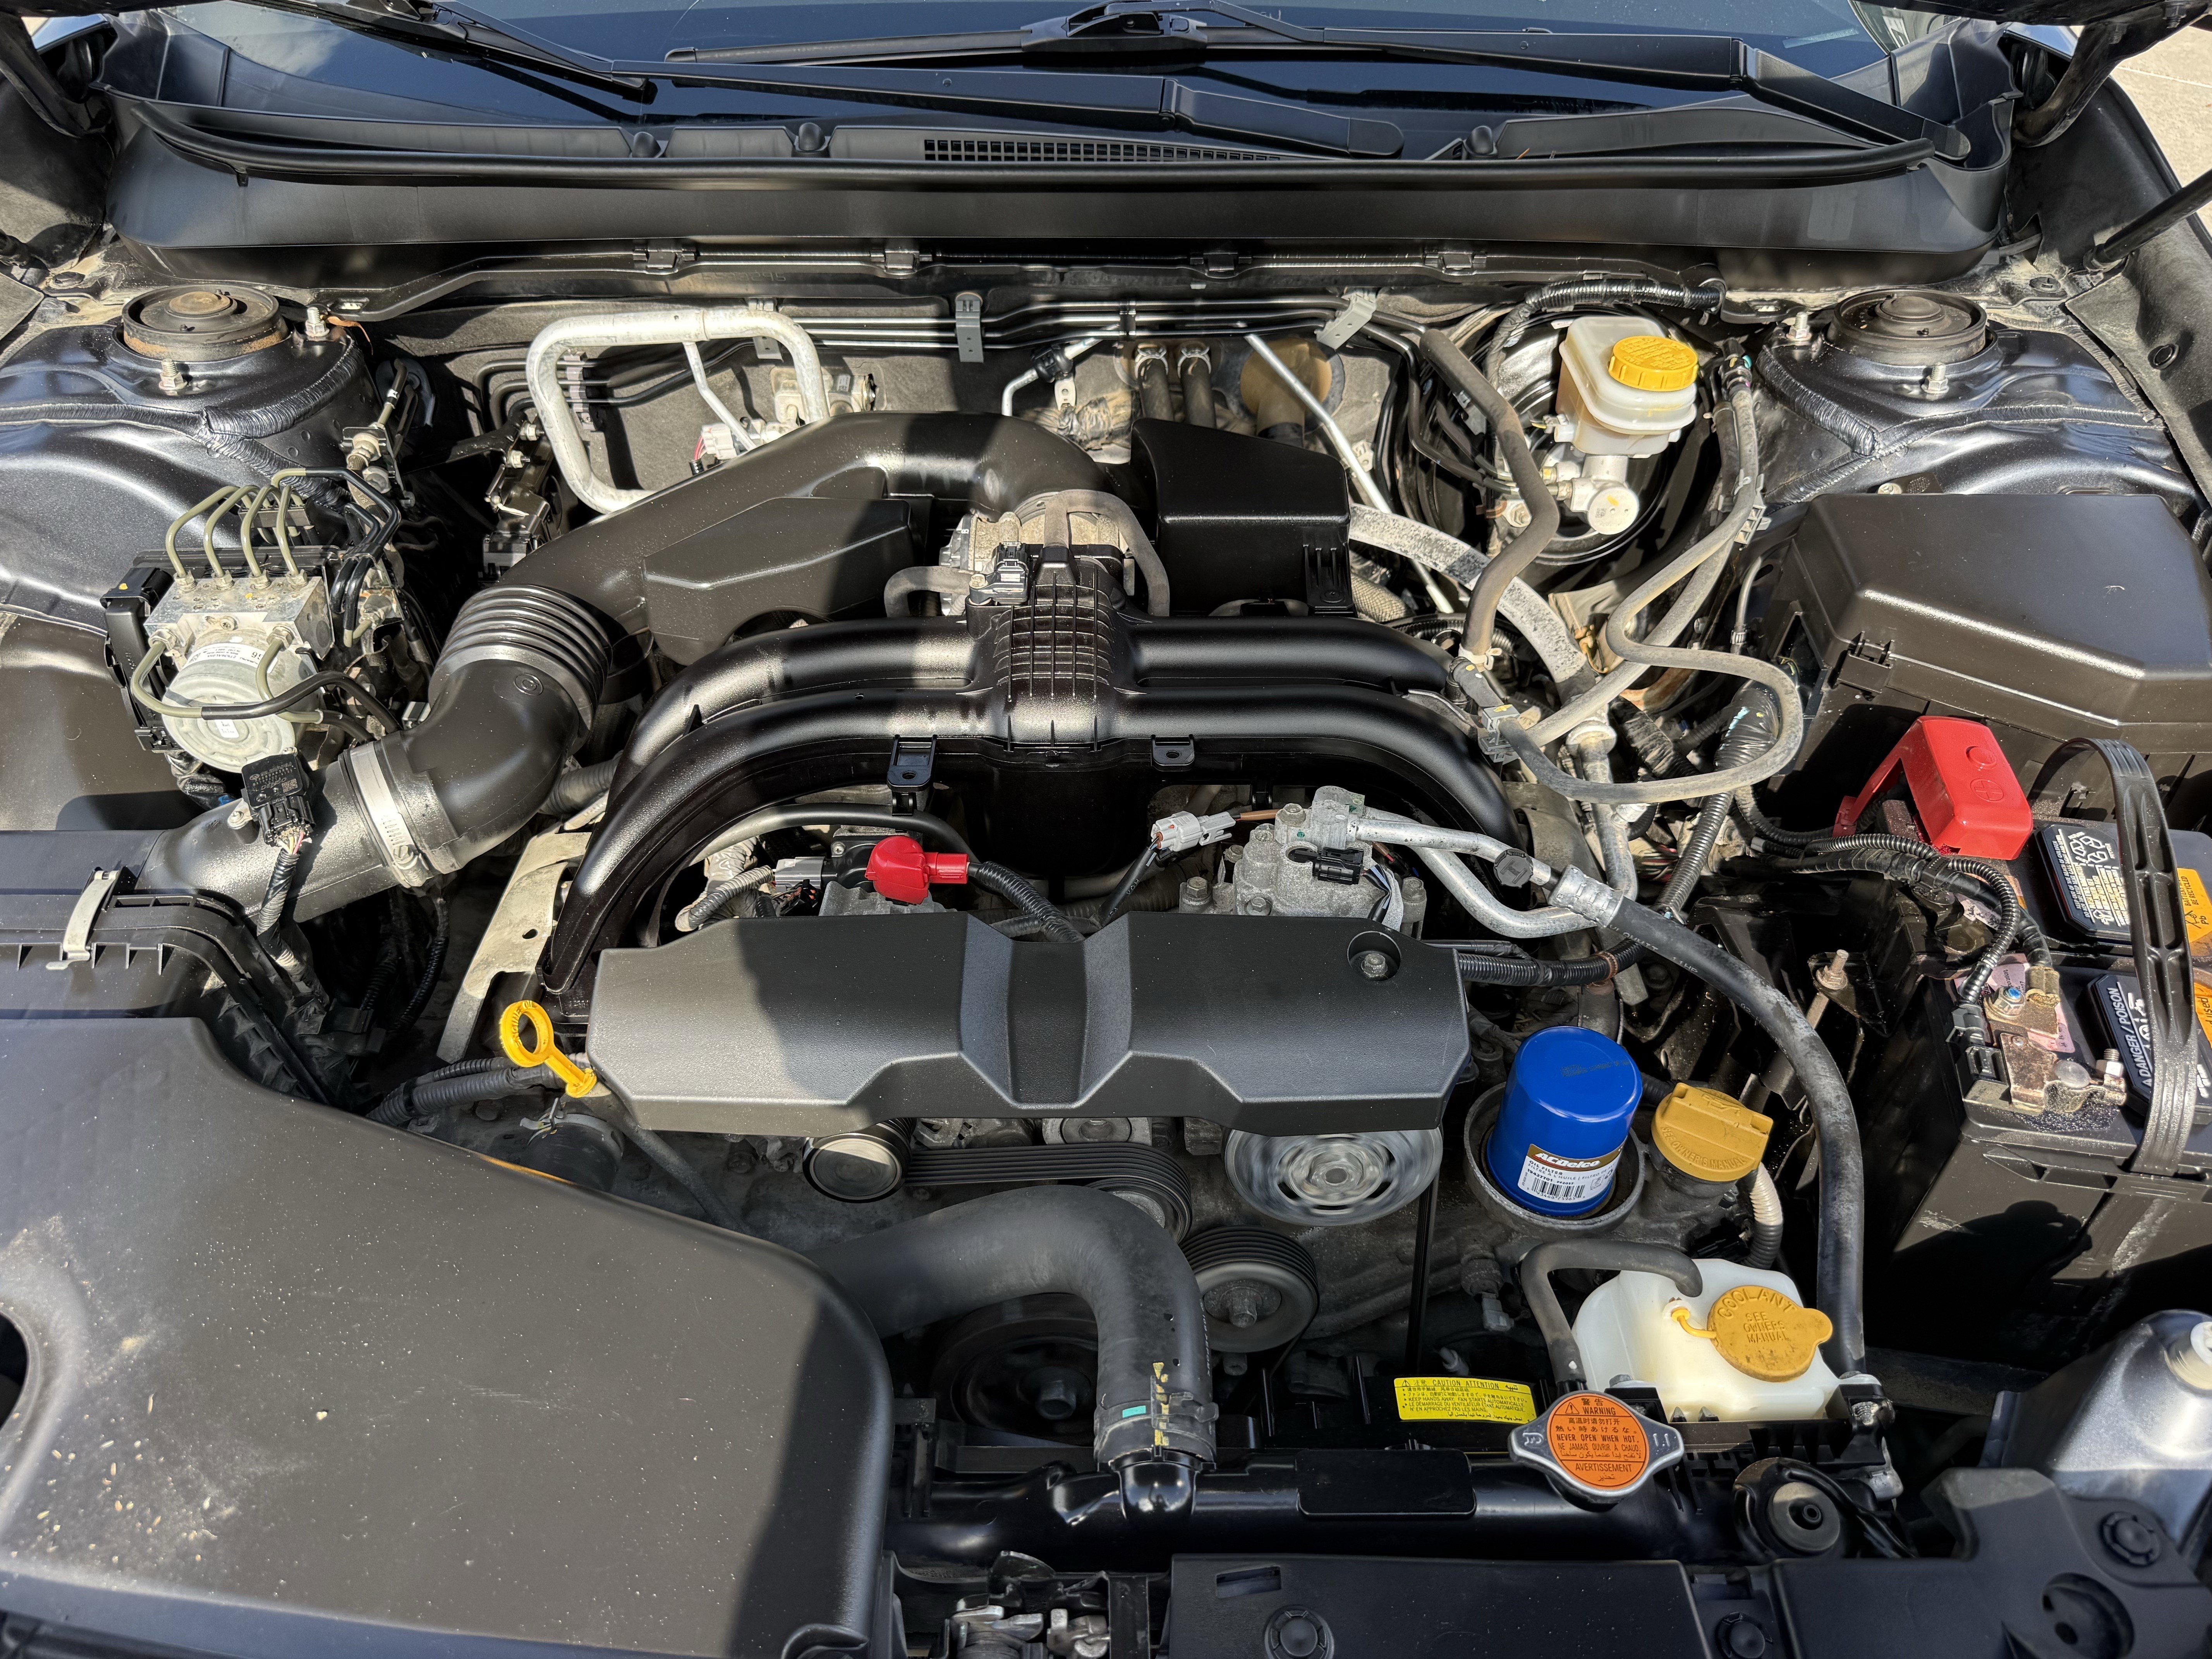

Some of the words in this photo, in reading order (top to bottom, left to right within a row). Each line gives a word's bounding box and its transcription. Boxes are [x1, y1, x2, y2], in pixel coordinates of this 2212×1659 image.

[2181, 876, 2196, 898] RECYCLED
[1661, 1127, 1675, 1142] SEE
[1672, 1141, 1708, 1167] OWNER'S
[1710, 1157, 1746, 1170] MANUAL
[1534, 1152, 1601, 1168] ACDelco
[1542, 1166, 1563, 1175] FILTER
[1717, 1288, 1797, 1319] COOLANT
[1745, 1312, 1768, 1322] SEE
[1747, 1331, 1790, 1343] MANUAL
[1465, 1380, 1499, 1389] ATTENTION
[1581, 1398, 1604, 1406] 警告
[1582, 1407, 1616, 1415] WARNING
[1623, 1435, 1640, 1443] HOT.
[1614, 1443, 1619, 1451] À
[1575, 1463, 1632, 1472] AVERTISSEMENT
